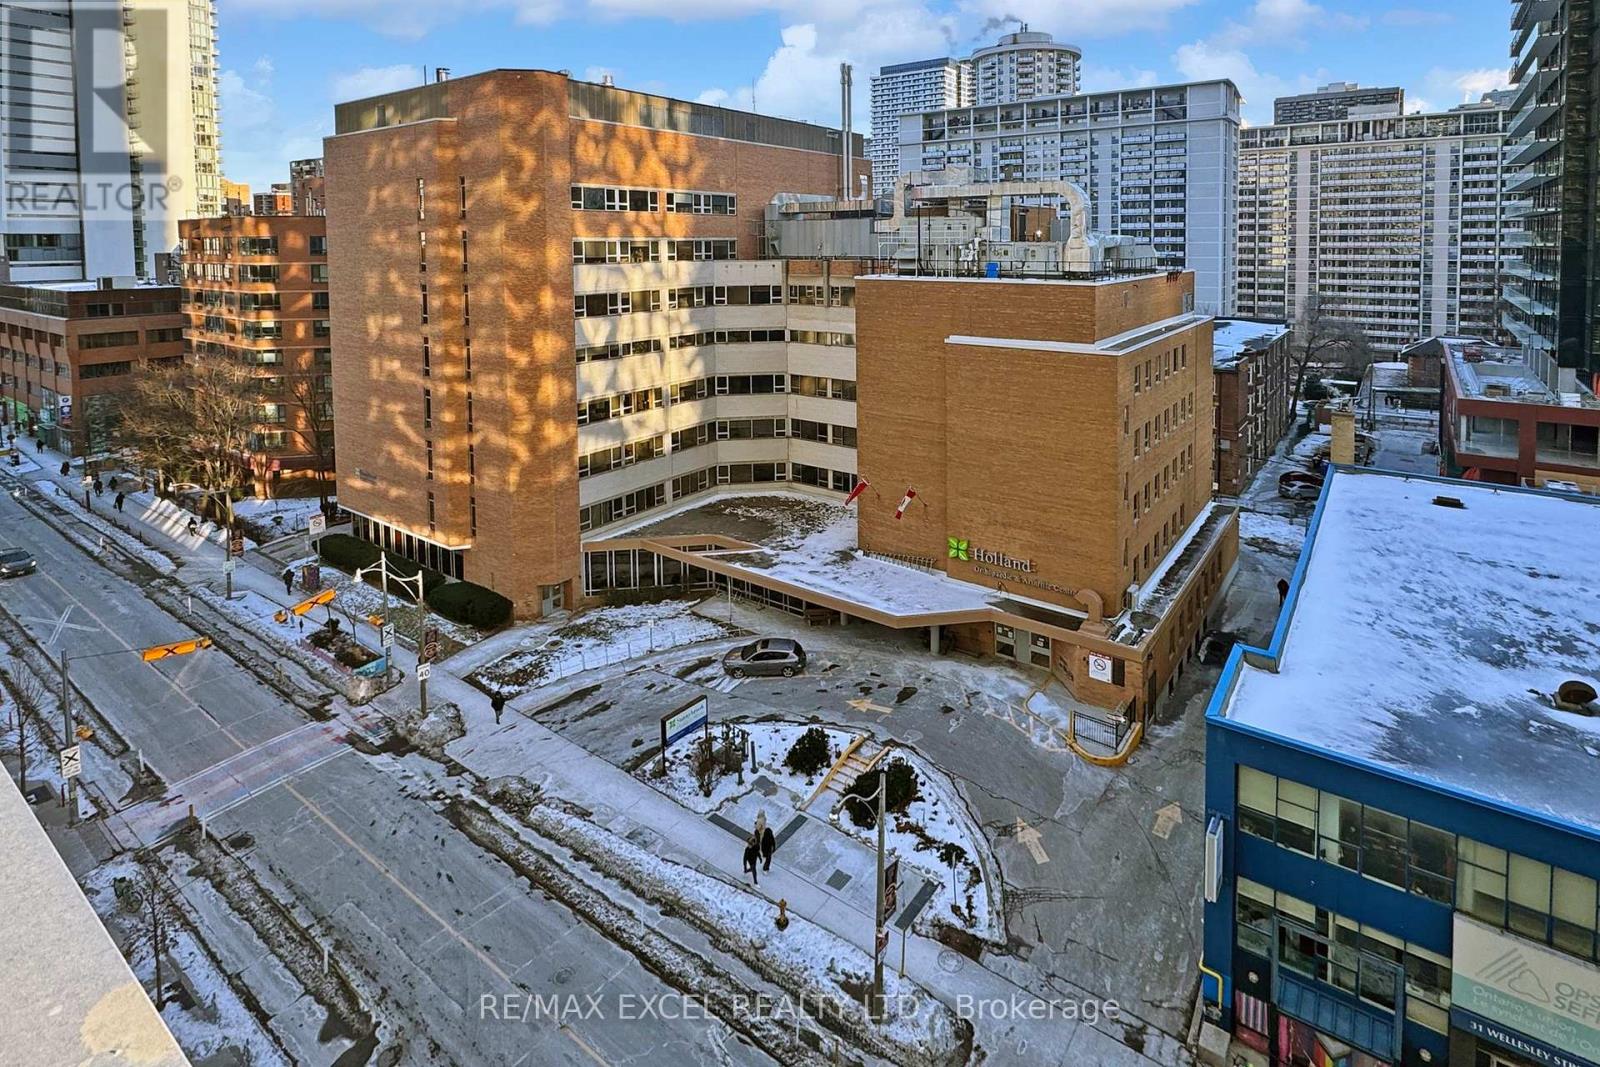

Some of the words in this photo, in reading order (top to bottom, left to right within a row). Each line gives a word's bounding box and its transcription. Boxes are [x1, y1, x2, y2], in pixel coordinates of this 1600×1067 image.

[974, 548, 1031, 573] Holland
[418, 669, 430, 678] 40
[1487, 1028, 1551, 1060] WELLESLEY
